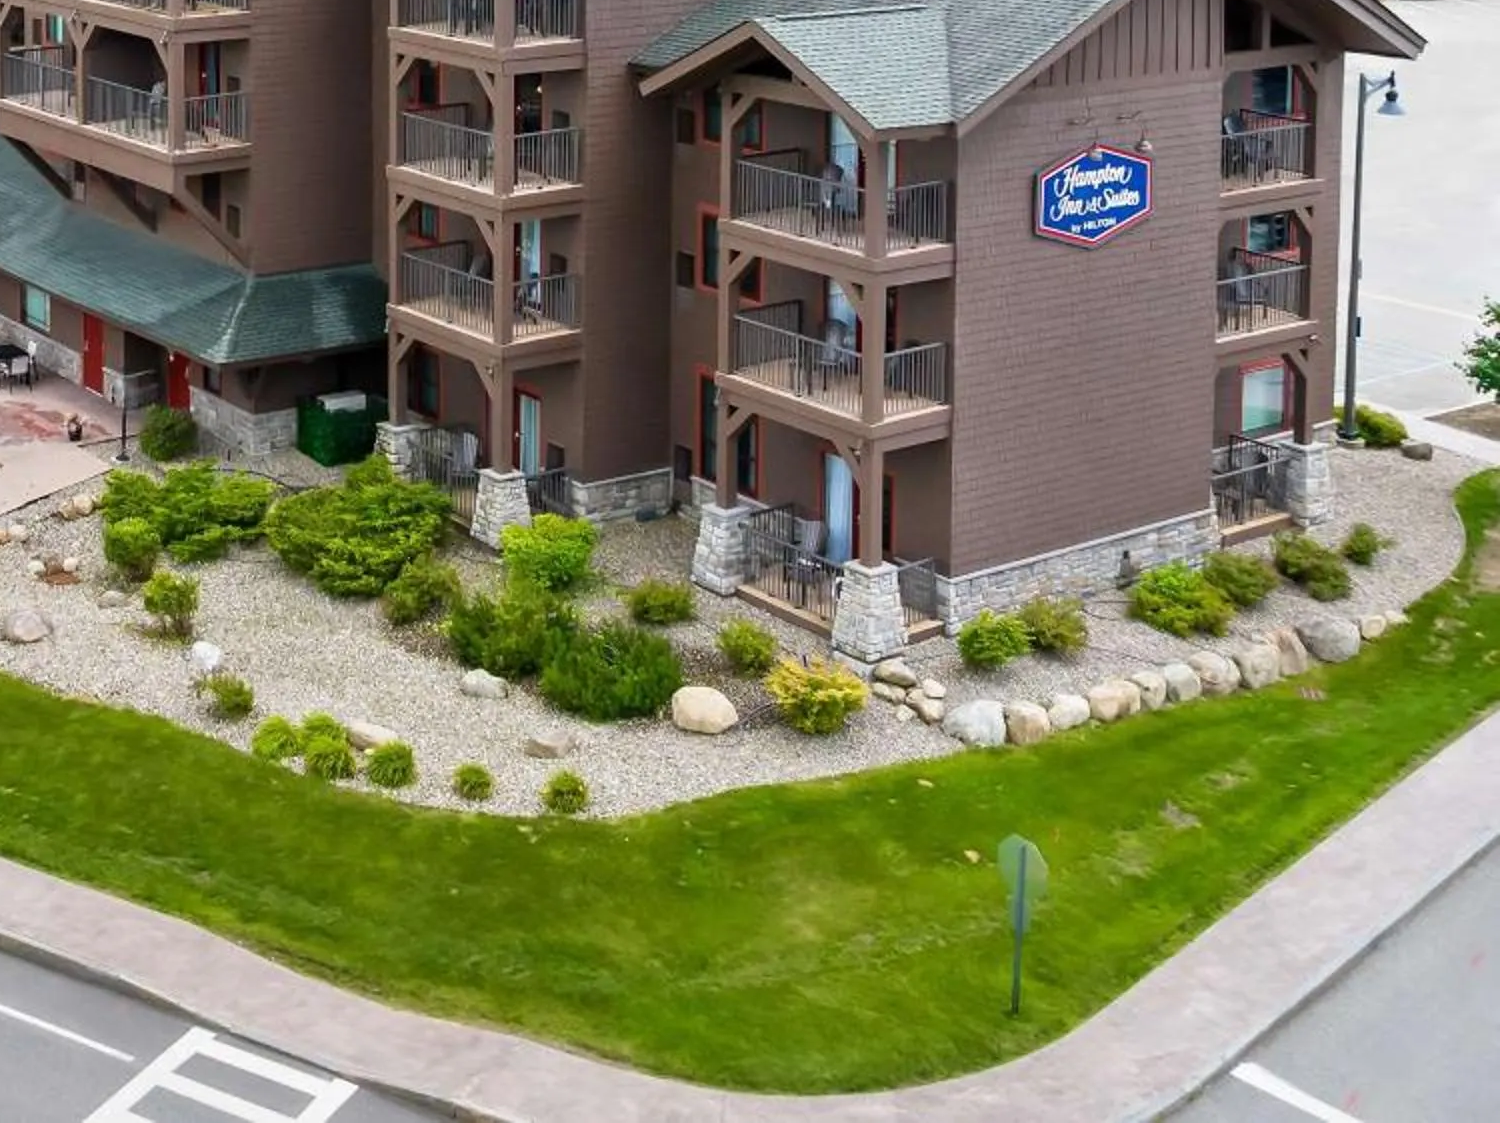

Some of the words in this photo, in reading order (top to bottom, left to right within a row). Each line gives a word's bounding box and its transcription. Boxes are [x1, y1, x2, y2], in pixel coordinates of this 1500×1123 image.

[1053, 163, 1132, 197] Hampton
[1050, 195, 1087, 221] Inn
[1097, 188, 1140, 211] Suites
[1083, 217, 1117, 230] HILTON
